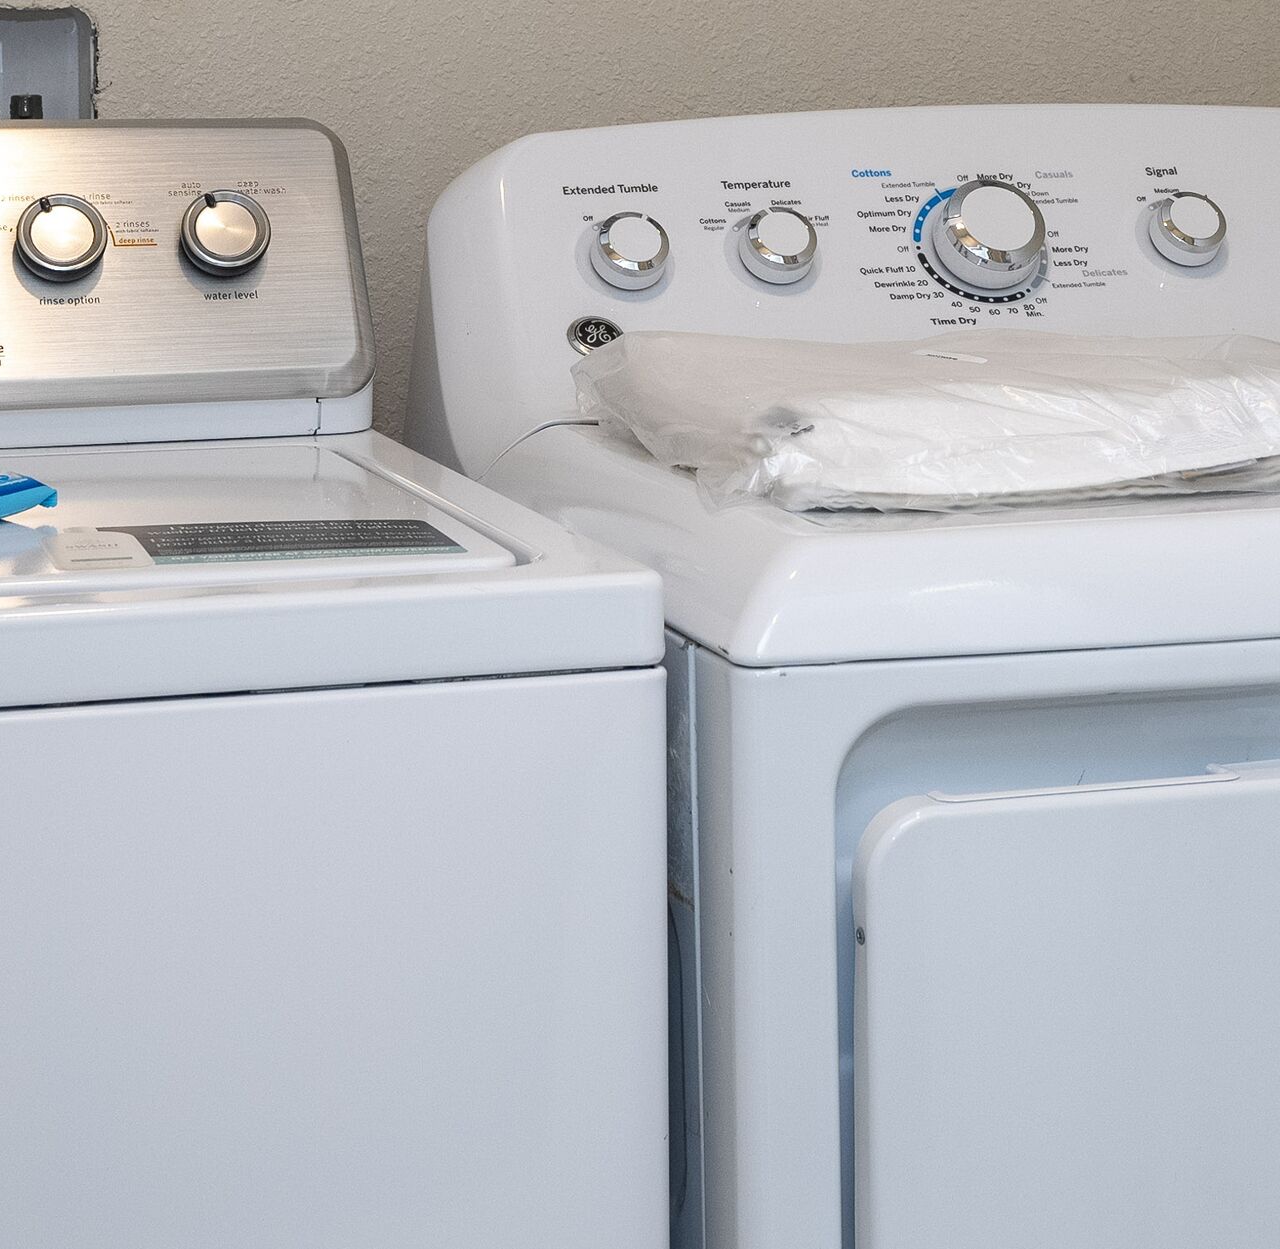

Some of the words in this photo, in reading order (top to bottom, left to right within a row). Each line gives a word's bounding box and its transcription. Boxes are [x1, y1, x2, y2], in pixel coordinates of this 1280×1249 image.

[851, 169, 892, 178] Cottons
[1034, 170, 1074, 179] Casuals
[1145, 166, 1178, 178] Signal
[956, 174, 970, 182] Off
[976, 173, 998, 181] More
[998, 173, 1014, 182] Dry
[180, 181, 202, 189] auto
[562, 185, 616, 196] Extended
[617, 182, 659, 194] Tumble
[720, 179, 791, 191] Temperature
[1016, 181, 1032, 190] Dry
[167, 188, 203, 198] sensing
[263, 186, 288, 195] wash
[1154, 187, 1180, 195] Medium
[7, 193, 36, 202] rinses
[88, 192, 111, 200] rinse
[885, 195, 904, 203] Less
[905, 195, 920, 203] Dry
[856, 210, 896, 219] Optimum
[897, 209, 912, 218] Dry
[122, 219, 151, 228] rinses
[699, 217, 727, 225] Cottons
[869, 225, 890, 233] More
[891, 225, 907, 234] Dry
[1047, 230, 1060, 238] Off
[118, 237, 137, 245] deep
[136, 236, 155, 244] rinse
[897, 245, 910, 253] Off
[1073, 245, 1089, 254] Dry
[1073, 259, 1088, 268] Dry
[859, 267, 884, 276] Quick
[885, 266, 904, 274] Fluff
[905, 265, 916, 273] 10
[1082, 268, 1129, 278] Delicates
[874, 280, 916, 289] Dewrinkle
[917, 279, 929, 287] 20
[203, 291, 232, 301] water
[233, 289, 259, 301] level
[889, 293, 915, 302] Damp
[916, 292, 932, 301] Dry
[932, 291, 945, 299] 30
[38, 296, 66, 306] rinse
[66, 295, 101, 307] option
[969, 305, 981, 313] 50
[1023, 303, 1036, 311] 80
[988, 308, 1001, 316] 60
[1026, 310, 1045, 318] Min.
[930, 317, 956, 326] Time
[957, 317, 977, 326] Dry
